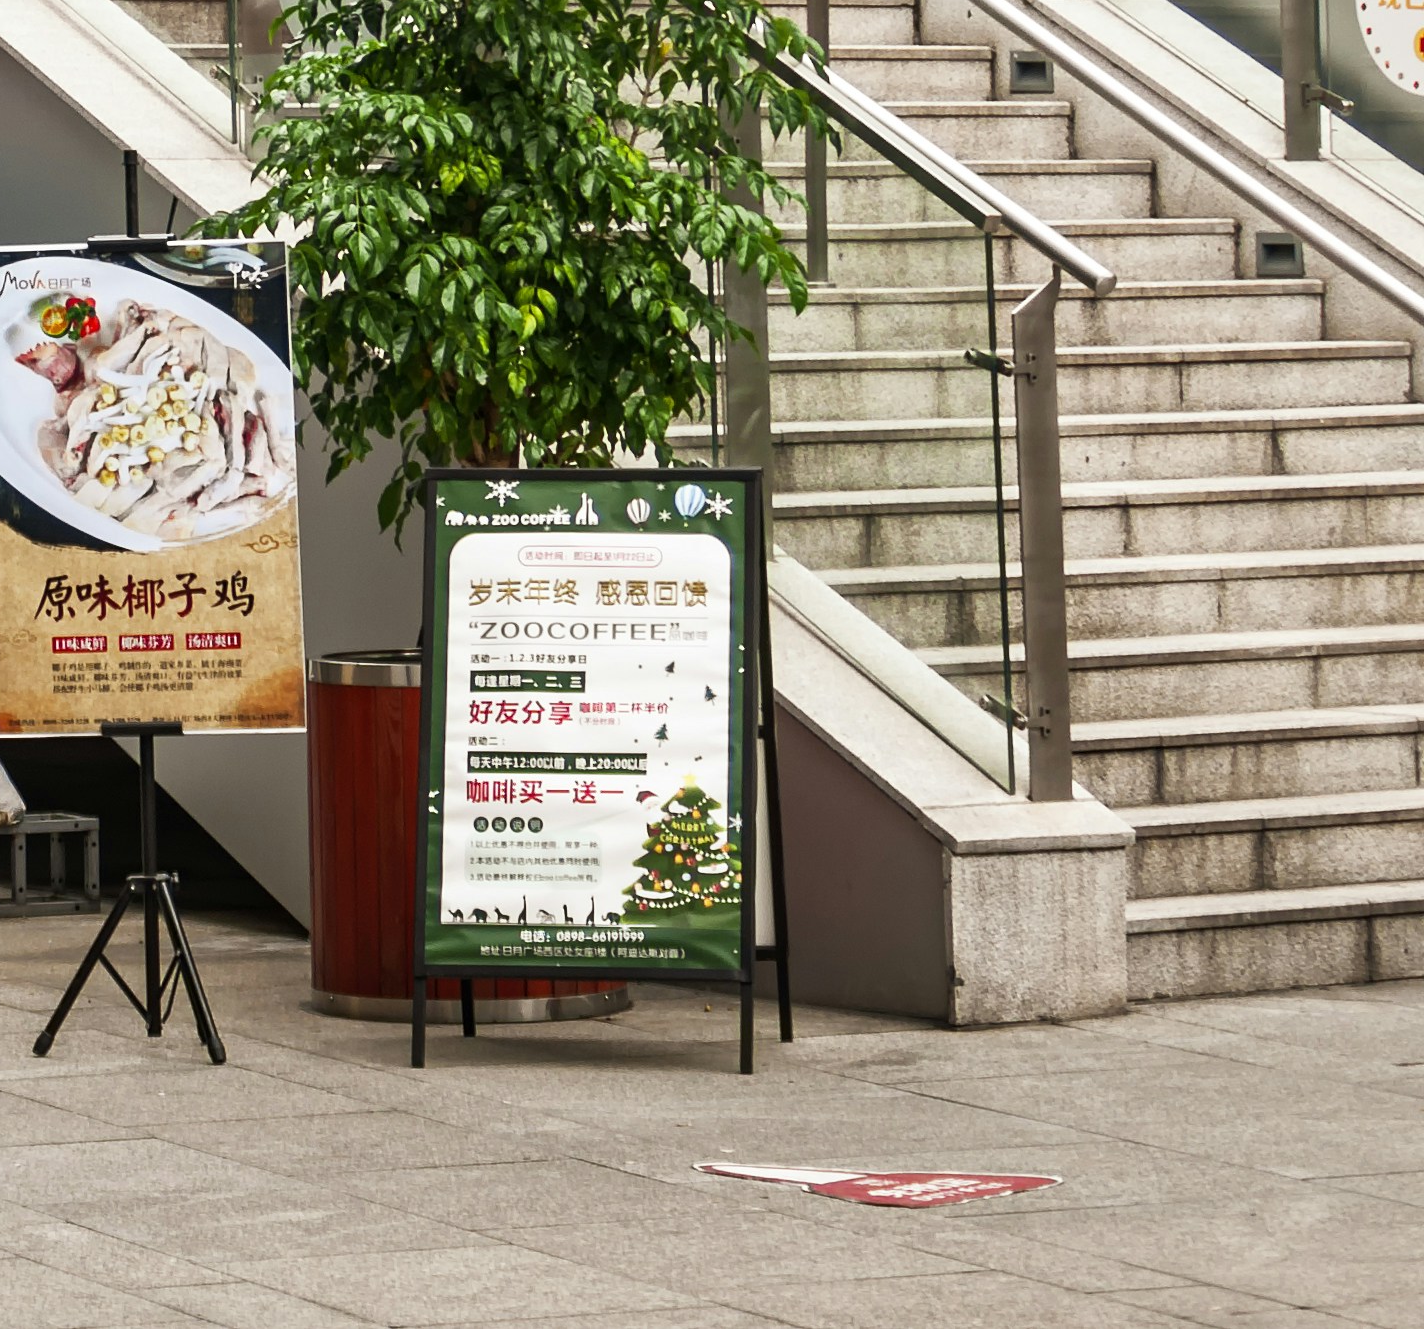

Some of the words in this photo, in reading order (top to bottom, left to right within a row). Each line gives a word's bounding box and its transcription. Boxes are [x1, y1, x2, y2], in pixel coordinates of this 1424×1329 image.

[48, 277, 91, 290] 日月广场
[492, 514, 519, 526] ZOO
[521, 514, 571, 526] COFFEE
[34, 569, 255, 622] 原味椰子鸡
[469, 578, 579, 606] 岁末年终
[596, 579, 708, 607] 感恩回馈
[55, 637, 105, 651] 口味咸鲜
[121, 635, 172, 650] 椰味芬芳
[188, 634, 238, 649] 汤清爽口
[469, 700, 574, 725] 好友分享
[579, 702, 669, 715] 咖啡第二杯半价
[466, 780, 624, 805] 咖啡买一送一
[556, 930, 644, 943] 0898-66191999
